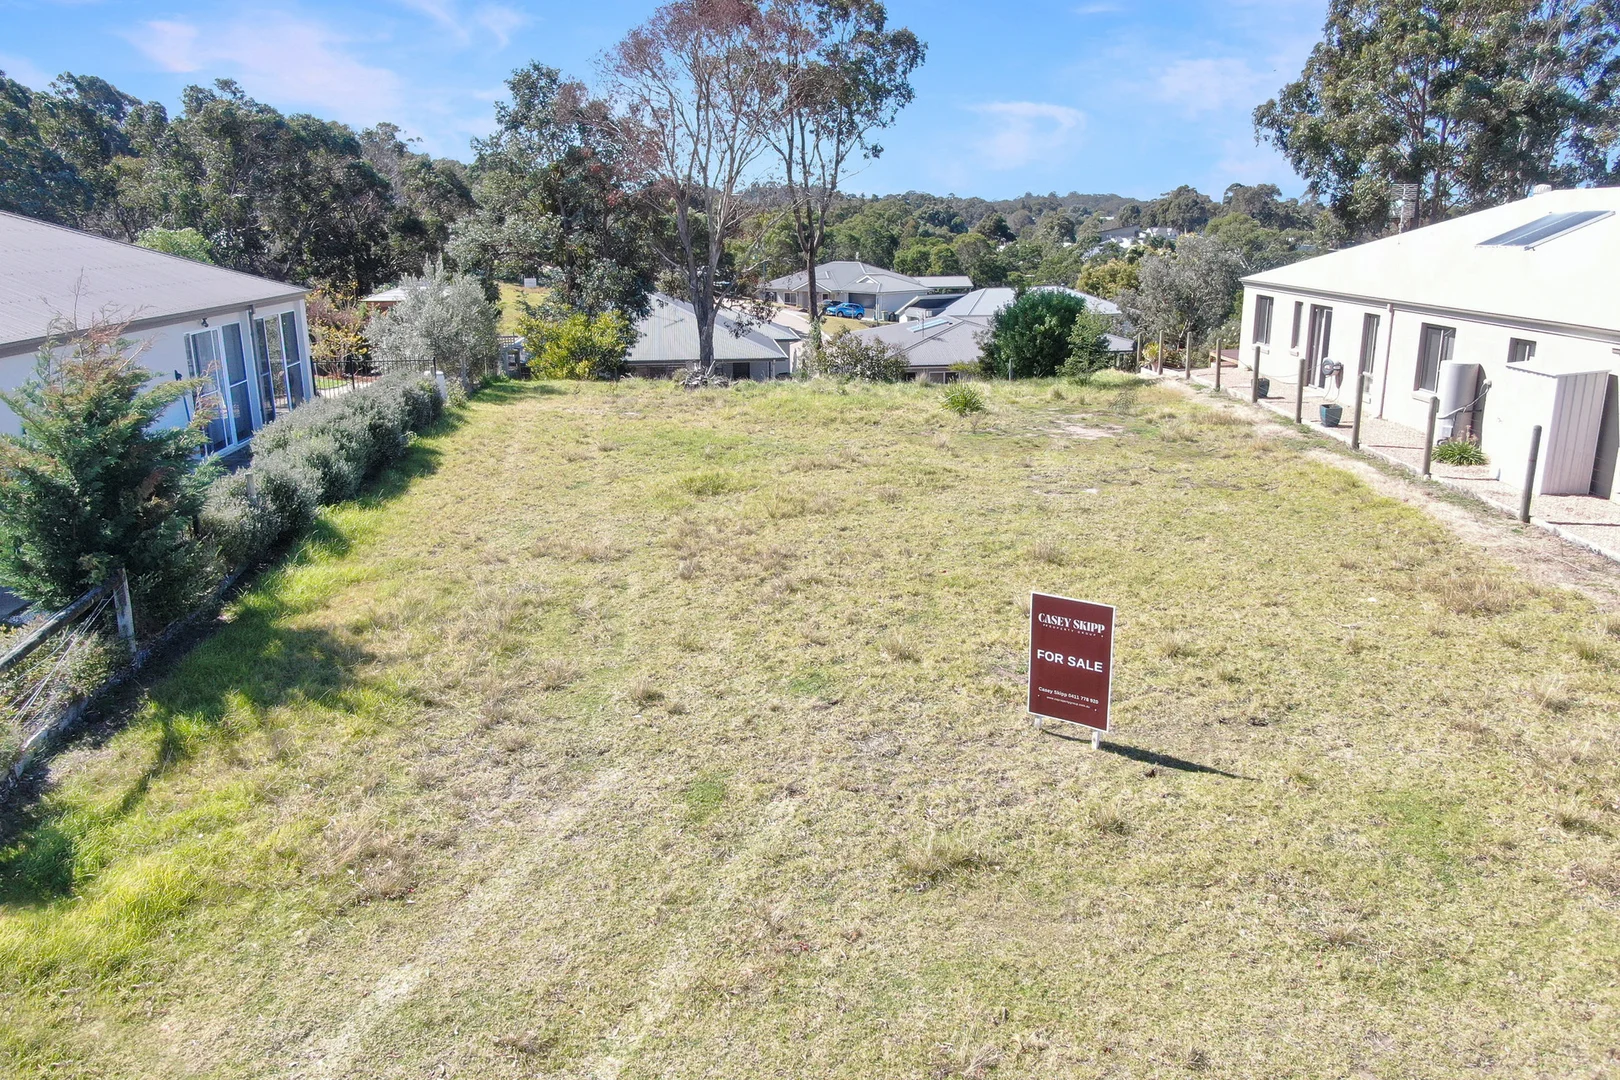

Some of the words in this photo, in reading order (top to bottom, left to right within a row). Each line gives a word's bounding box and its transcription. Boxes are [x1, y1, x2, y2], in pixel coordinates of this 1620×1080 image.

[1038, 613, 1071, 627] CASEY
[1073, 619, 1105, 633] SKIPP
[1037, 649, 1063, 664] FOR
[1067, 656, 1103, 672] SALE
[1038, 686, 1053, 694] Casey
